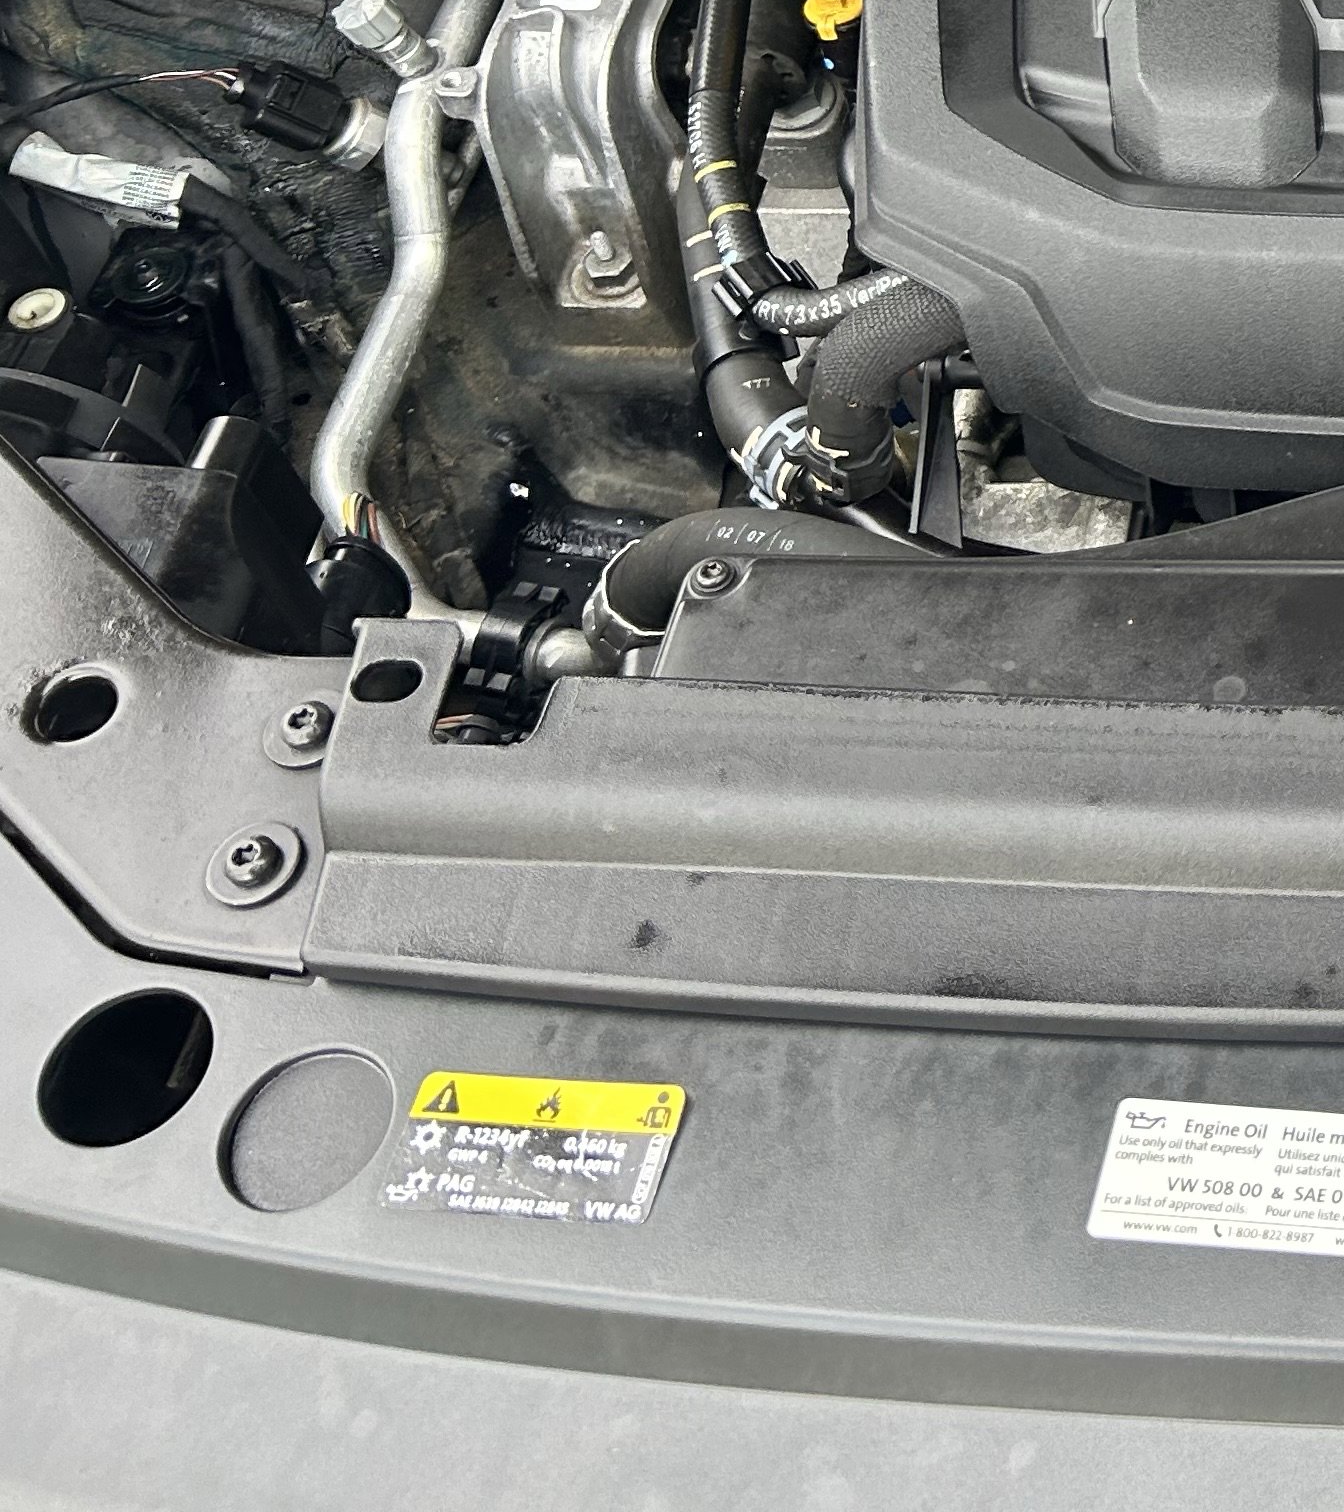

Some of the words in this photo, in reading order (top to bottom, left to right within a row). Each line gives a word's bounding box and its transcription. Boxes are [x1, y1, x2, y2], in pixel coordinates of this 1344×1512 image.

[1184, 1119, 1239, 1138] Engine
[1244, 1123, 1267, 1138] Oil
[1282, 1127, 1325, 1143] Huile
[1118, 1135, 1140, 1146] Use
[1141, 1137, 1166, 1150] only
[1168, 1138, 1183, 1149] oil
[1185, 1139, 1208, 1151] that
[1210, 1143, 1262, 1158] expressly
[1278, 1148, 1320, 1161] Utilisez
[1115, 1150, 1164, 1164] complies
[1167, 1153, 1193, 1164] with
[1295, 1165, 1340, 1177] satisfait
[436, 1173, 475, 1192] PAG
[1168, 1177, 1198, 1192] VW
[1202, 1179, 1234, 1195] 508
[1239, 1182, 1262, 1197] 00
[1271, 1187, 1284, 1199] &
[1294, 1186, 1326, 1202] SAE
[584, 1200, 615, 1219] VW
[613, 1203, 644, 1221] AG
[1103, 1192, 1122, 1204] For
[1124, 1196, 1131, 1205] a
[1134, 1194, 1151, 1207] list
[1153, 1196, 1168, 1207] of
[1168, 1200, 1223, 1212] approved
[1265, 1205, 1291, 1217] Pour
[1293, 1210, 1315, 1219] une
[1317, 1208, 1340, 1221] liste
